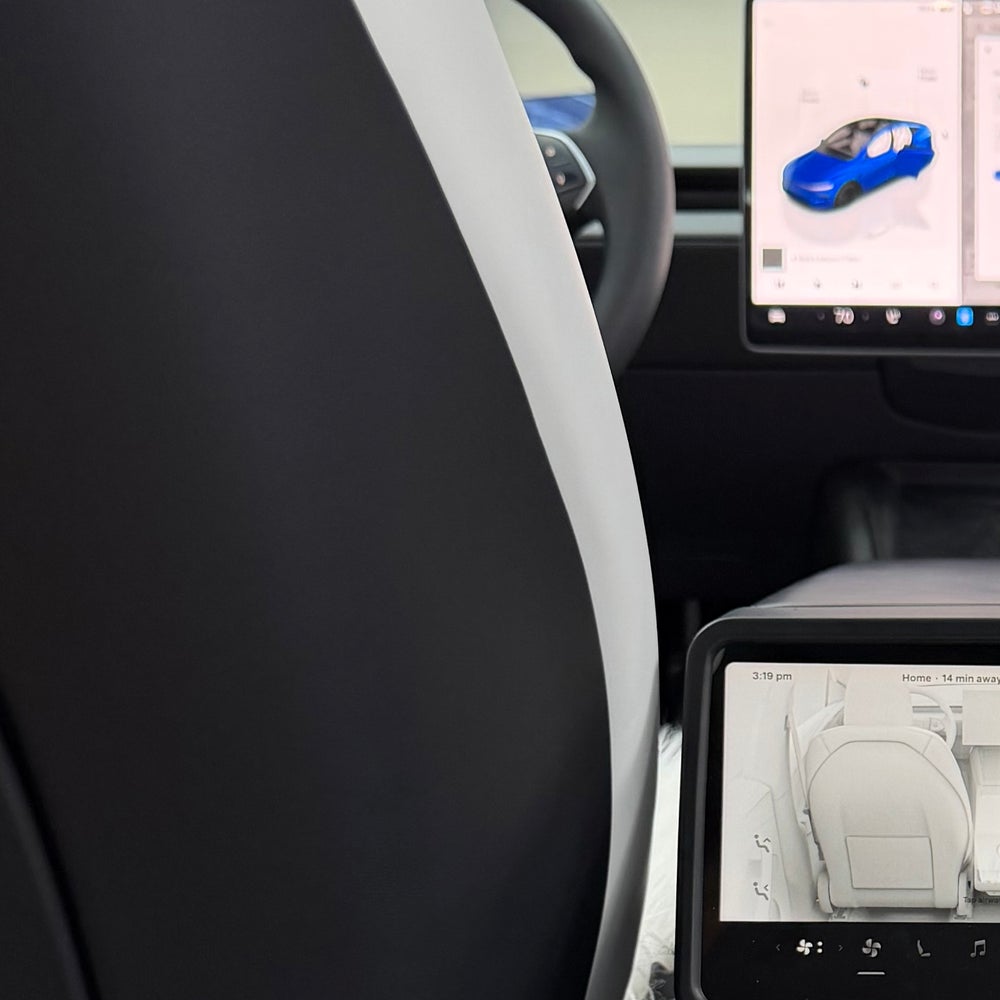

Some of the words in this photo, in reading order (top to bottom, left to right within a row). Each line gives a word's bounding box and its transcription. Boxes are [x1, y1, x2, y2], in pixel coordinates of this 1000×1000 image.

[752, 671, 773, 681] 3:19
[775, 673, 792, 683] pm
[902, 673, 932, 683] Home
[942, 673, 953, 683] 14
[955, 673, 974, 683] min
[963, 896, 976, 905] Tap
